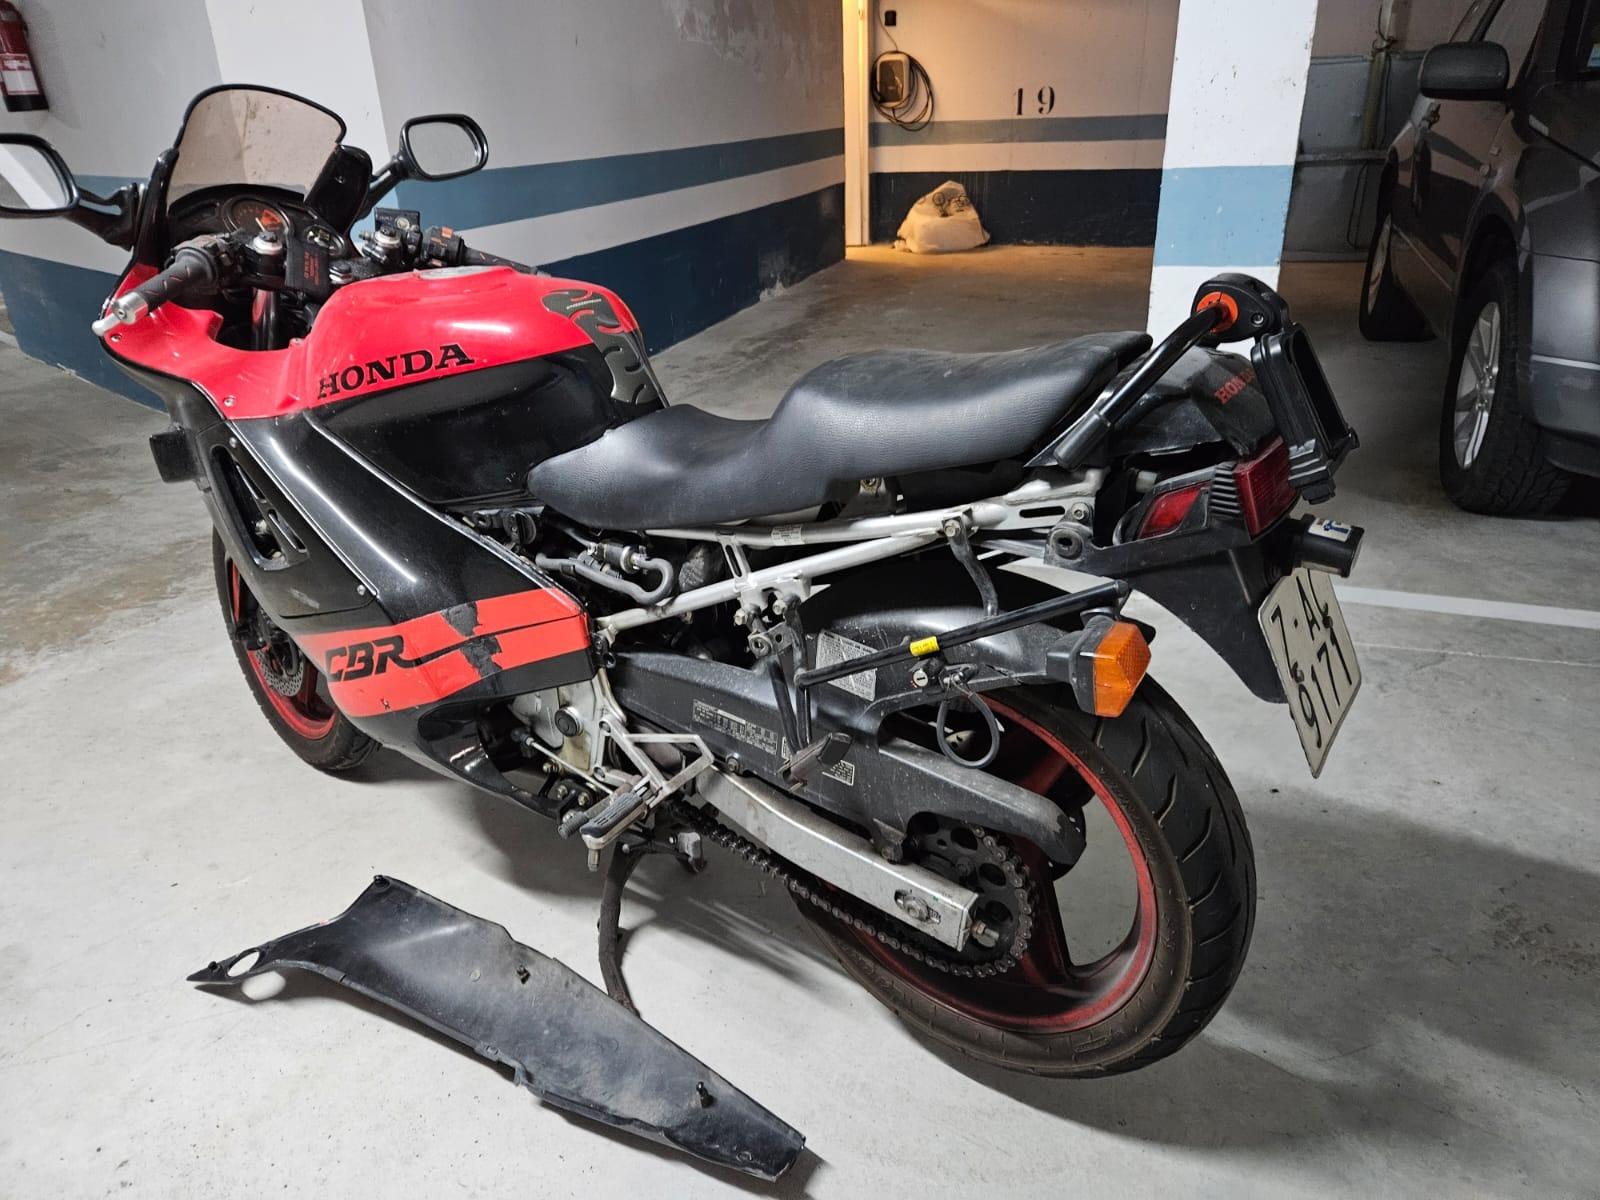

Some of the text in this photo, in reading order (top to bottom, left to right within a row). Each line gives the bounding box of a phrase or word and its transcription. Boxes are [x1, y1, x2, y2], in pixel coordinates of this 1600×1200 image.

[1013, 86, 1055, 116] 19
[318, 343, 475, 399] HONDA
[325, 635, 408, 682] CBR
[1299, 628, 1352, 749] 9171
